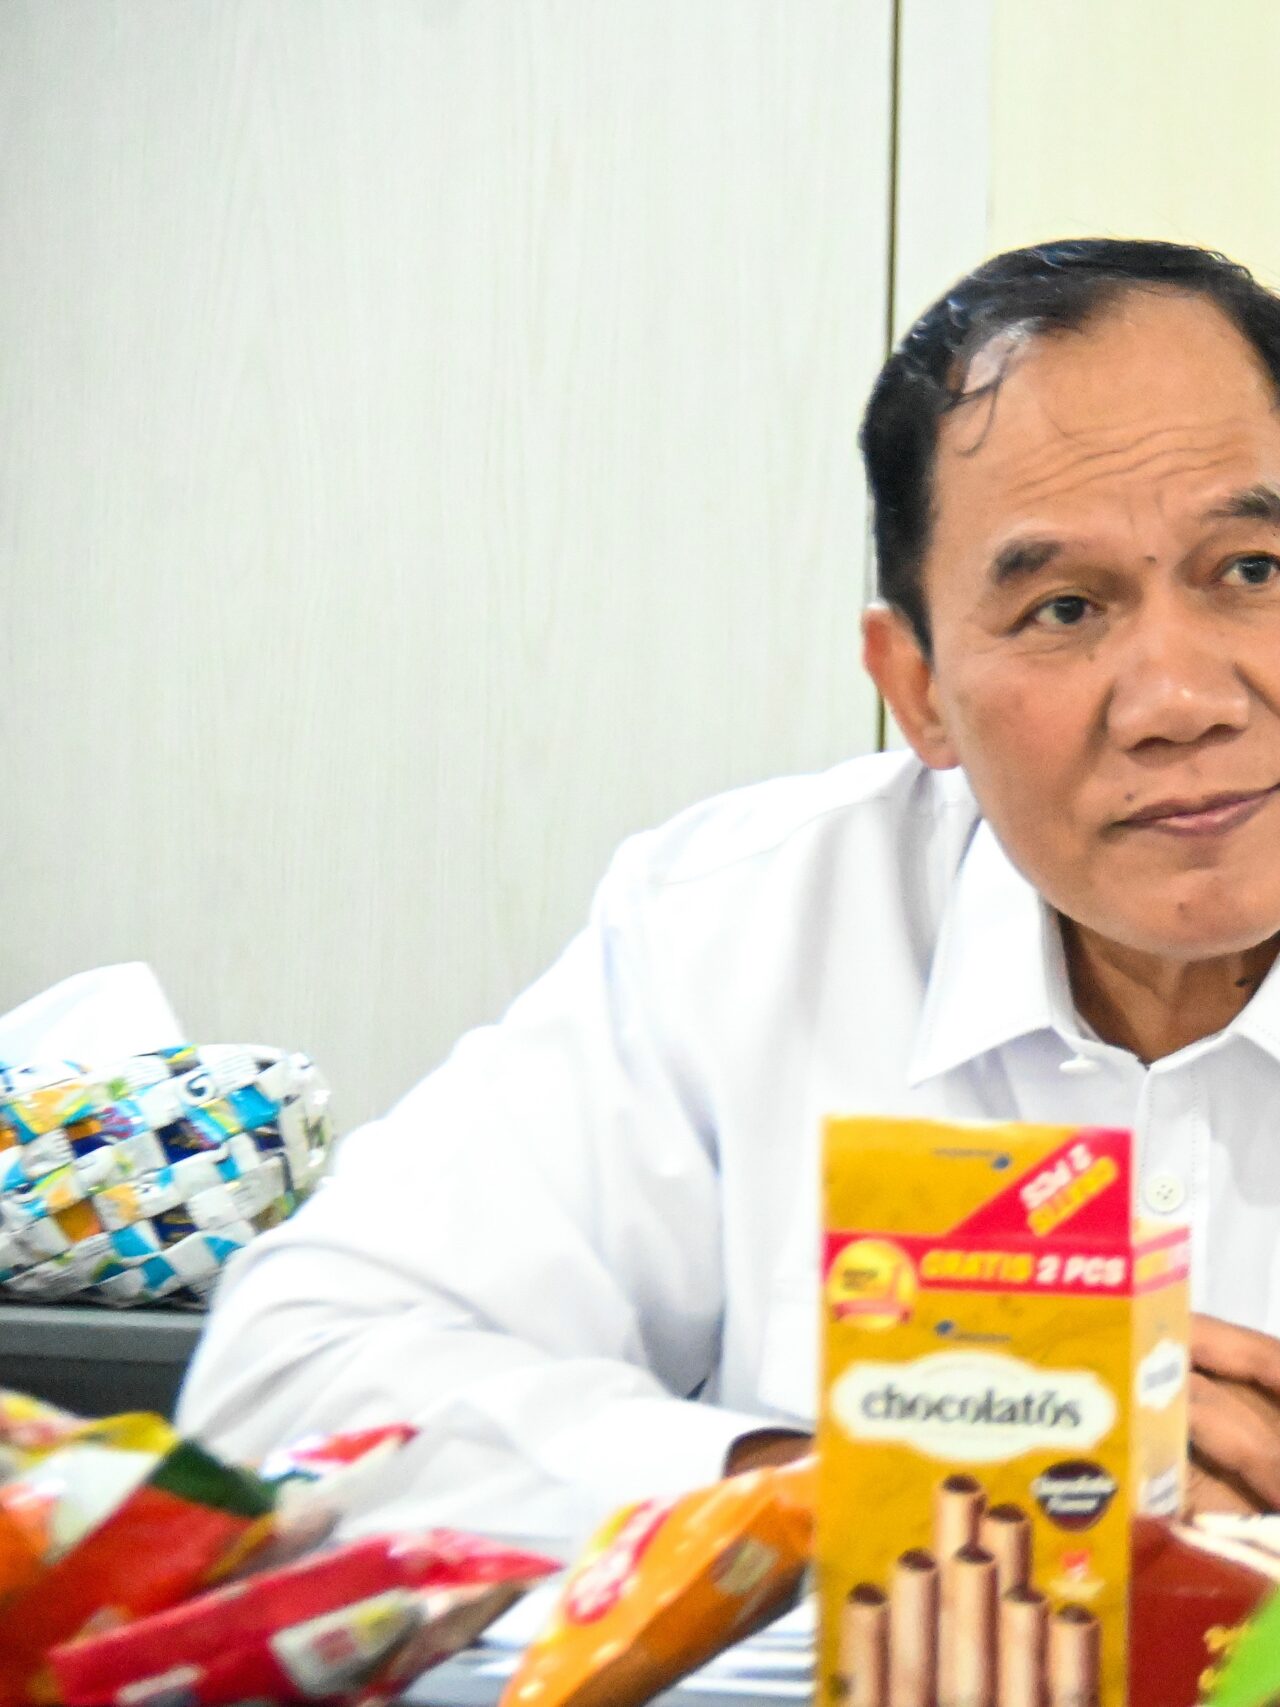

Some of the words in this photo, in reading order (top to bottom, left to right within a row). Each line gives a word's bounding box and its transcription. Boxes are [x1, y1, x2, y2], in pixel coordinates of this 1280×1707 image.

[921, 1249, 1034, 1283] GRATIS
[1036, 1255, 1061, 1284] 2
[1062, 1255, 1126, 1287] PCS
